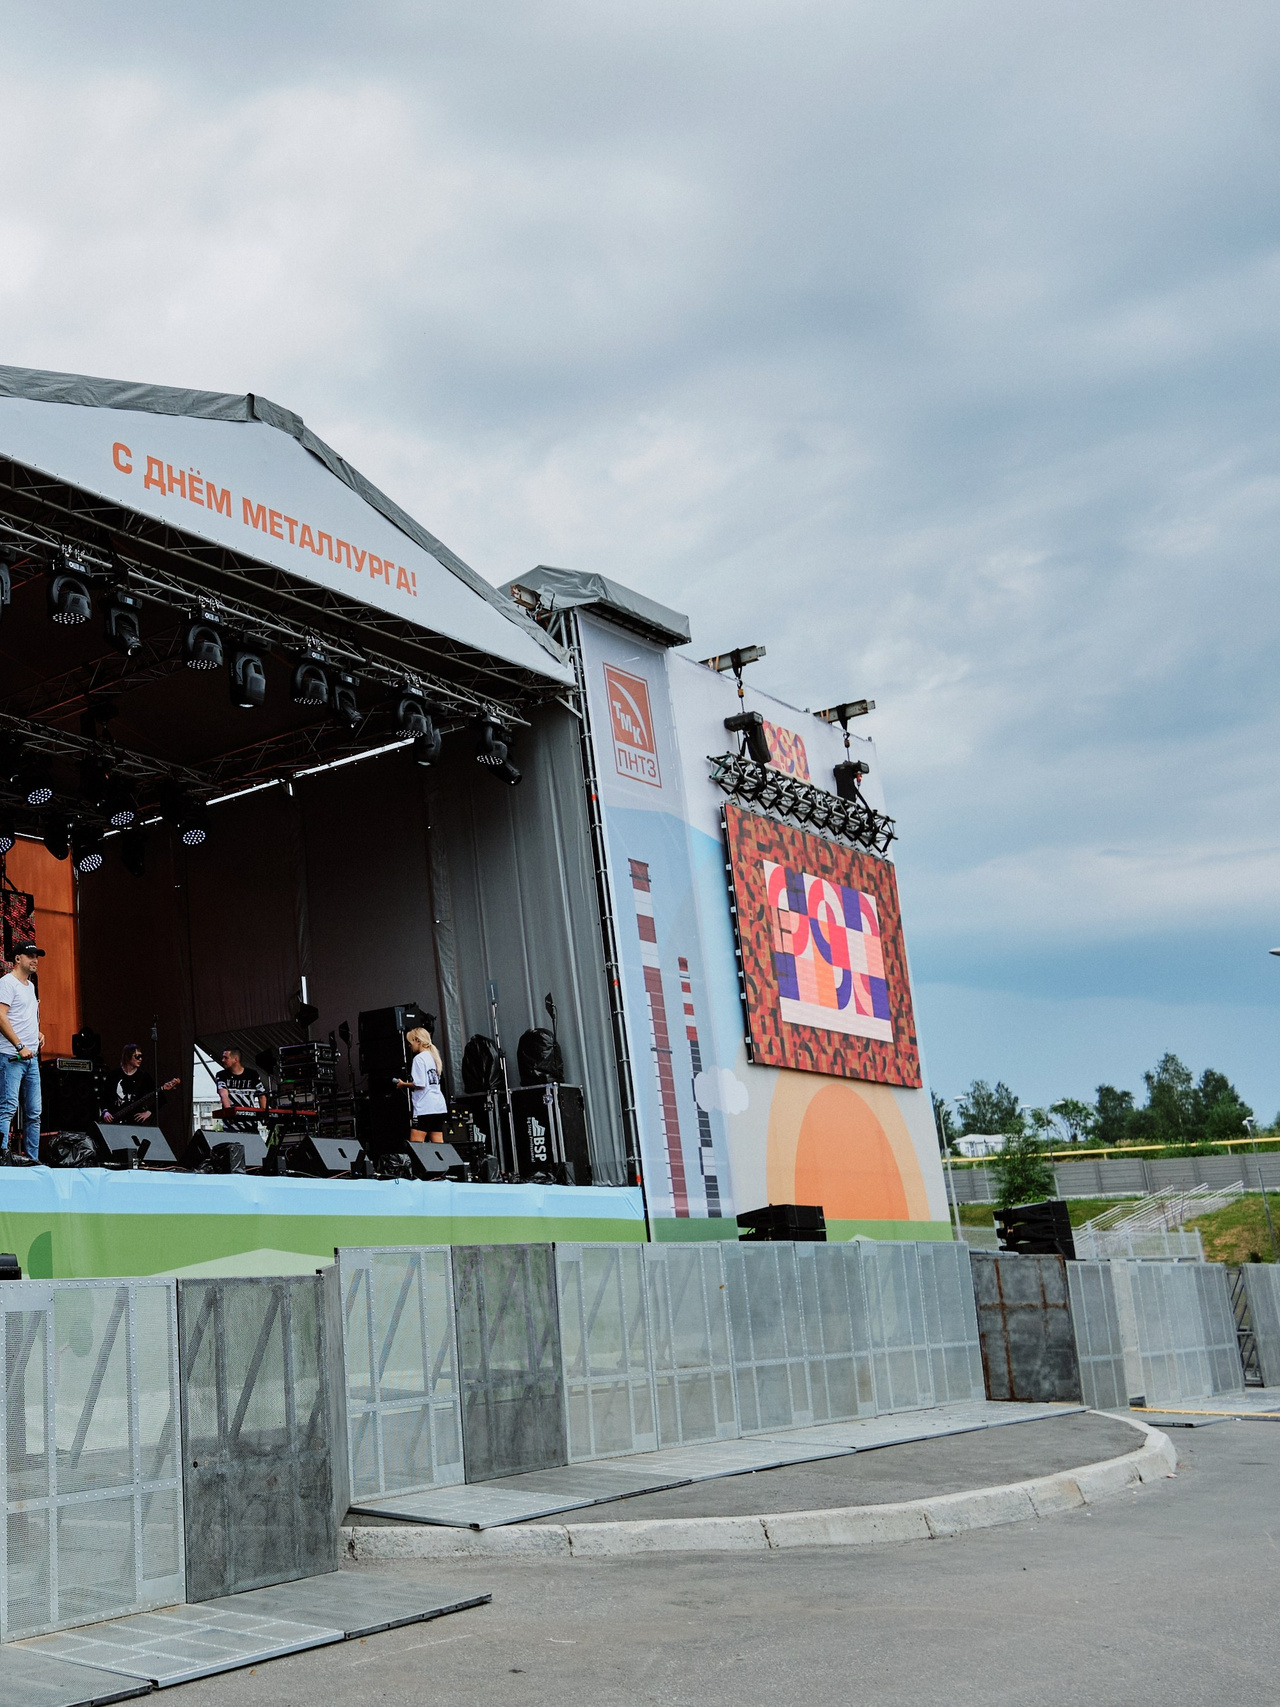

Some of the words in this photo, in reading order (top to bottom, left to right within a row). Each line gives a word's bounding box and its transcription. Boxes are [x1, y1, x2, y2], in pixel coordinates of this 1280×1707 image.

[112, 442, 133, 475] С
[143, 455, 232, 518] ДНЁМ
[242, 496, 418, 597] МЕТАЛЛУРГА!
[612, 700, 643, 746] ТМК
[617, 747, 657, 778] ПНТЗ
[226, 1079, 252, 1088] WHITE
[533, 1136, 547, 1162] BSP
